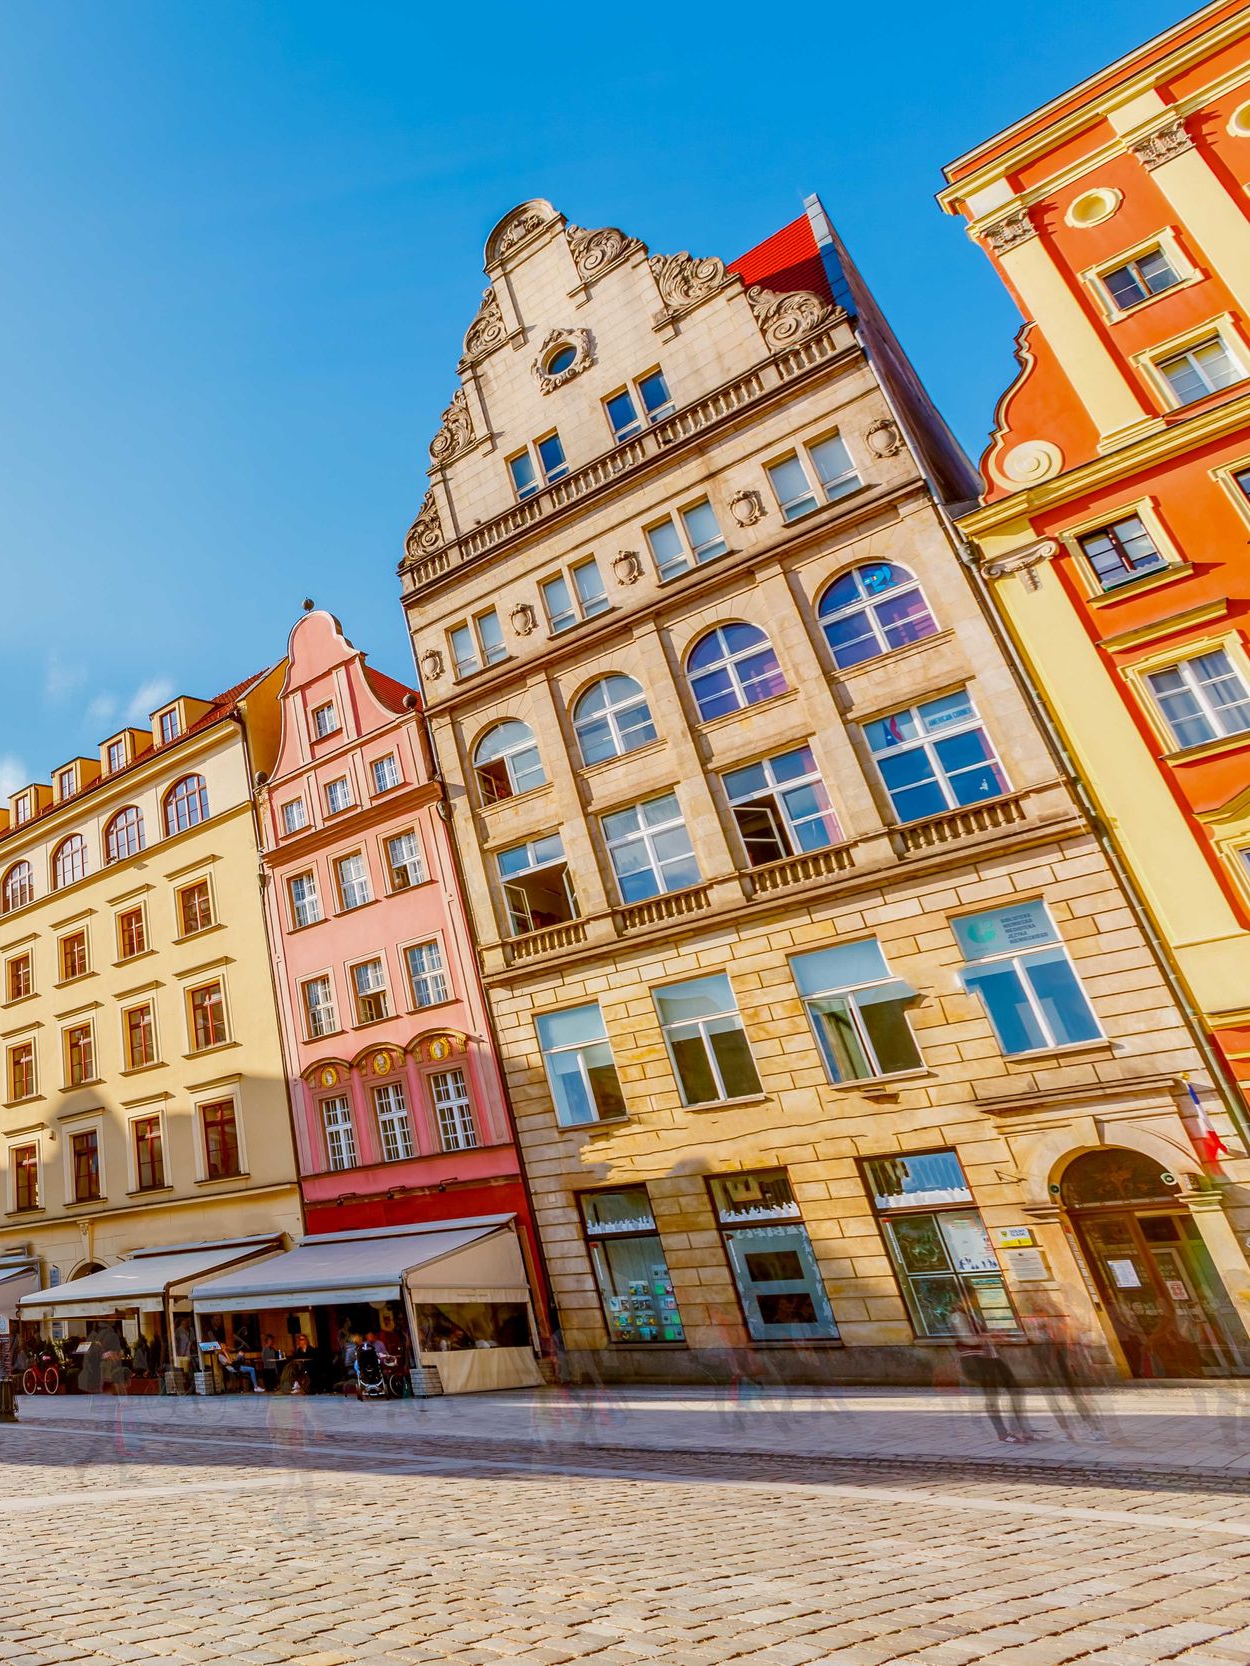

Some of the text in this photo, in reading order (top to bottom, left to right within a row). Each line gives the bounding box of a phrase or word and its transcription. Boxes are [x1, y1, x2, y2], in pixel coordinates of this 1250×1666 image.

[929, 707, 971, 726] AMERICAN CORNER
[1001, 913, 1031, 923] BIBLIOTEKA
[1005, 923, 1036, 933] MEDIOTEKA
[1009, 932, 1048, 944] NIEMIECKIEGO
